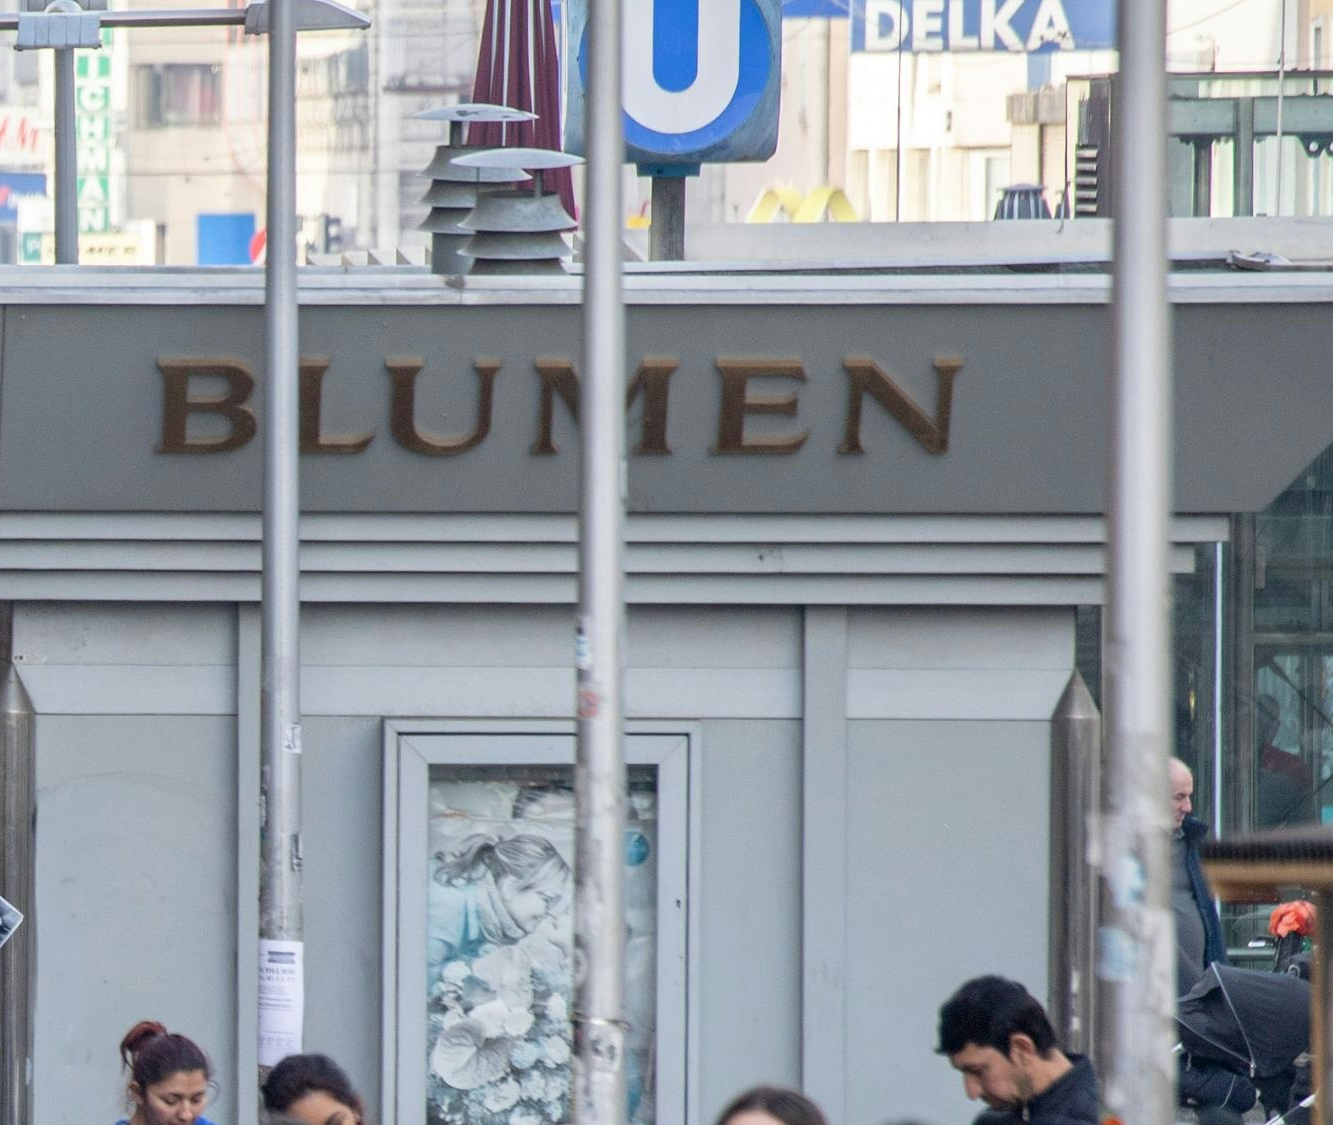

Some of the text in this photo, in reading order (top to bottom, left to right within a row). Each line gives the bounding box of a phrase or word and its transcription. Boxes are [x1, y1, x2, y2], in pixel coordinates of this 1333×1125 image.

[620, 0, 741, 134] U
[864, 0, 1076, 51] DELKA
[154, 356, 966, 458] BLUMEN
